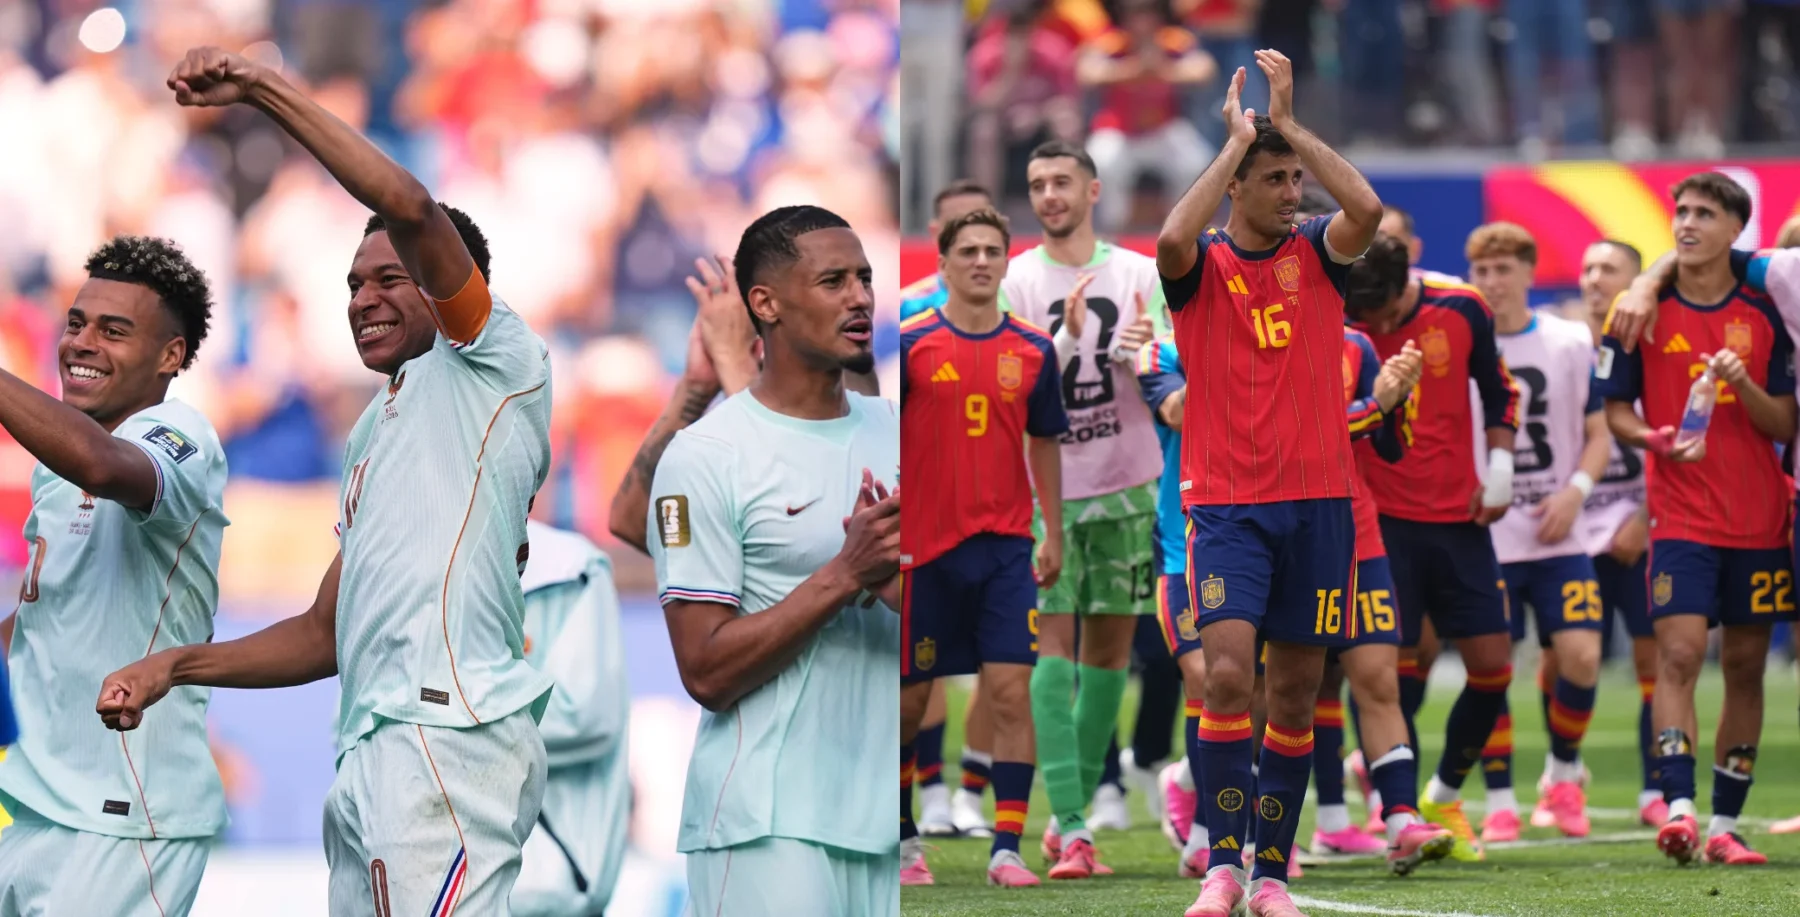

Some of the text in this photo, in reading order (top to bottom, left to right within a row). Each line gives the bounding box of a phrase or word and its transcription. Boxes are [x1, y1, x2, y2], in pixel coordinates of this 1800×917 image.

[1251, 303, 1292, 349] 16
[966, 394, 988, 437] 9
[1130, 561, 1154, 604] 13
[1561, 579, 1603, 622] 25
[1751, 569, 1795, 613] 22
[1315, 588, 1342, 635] 16
[1357, 589, 1396, 634] 15
